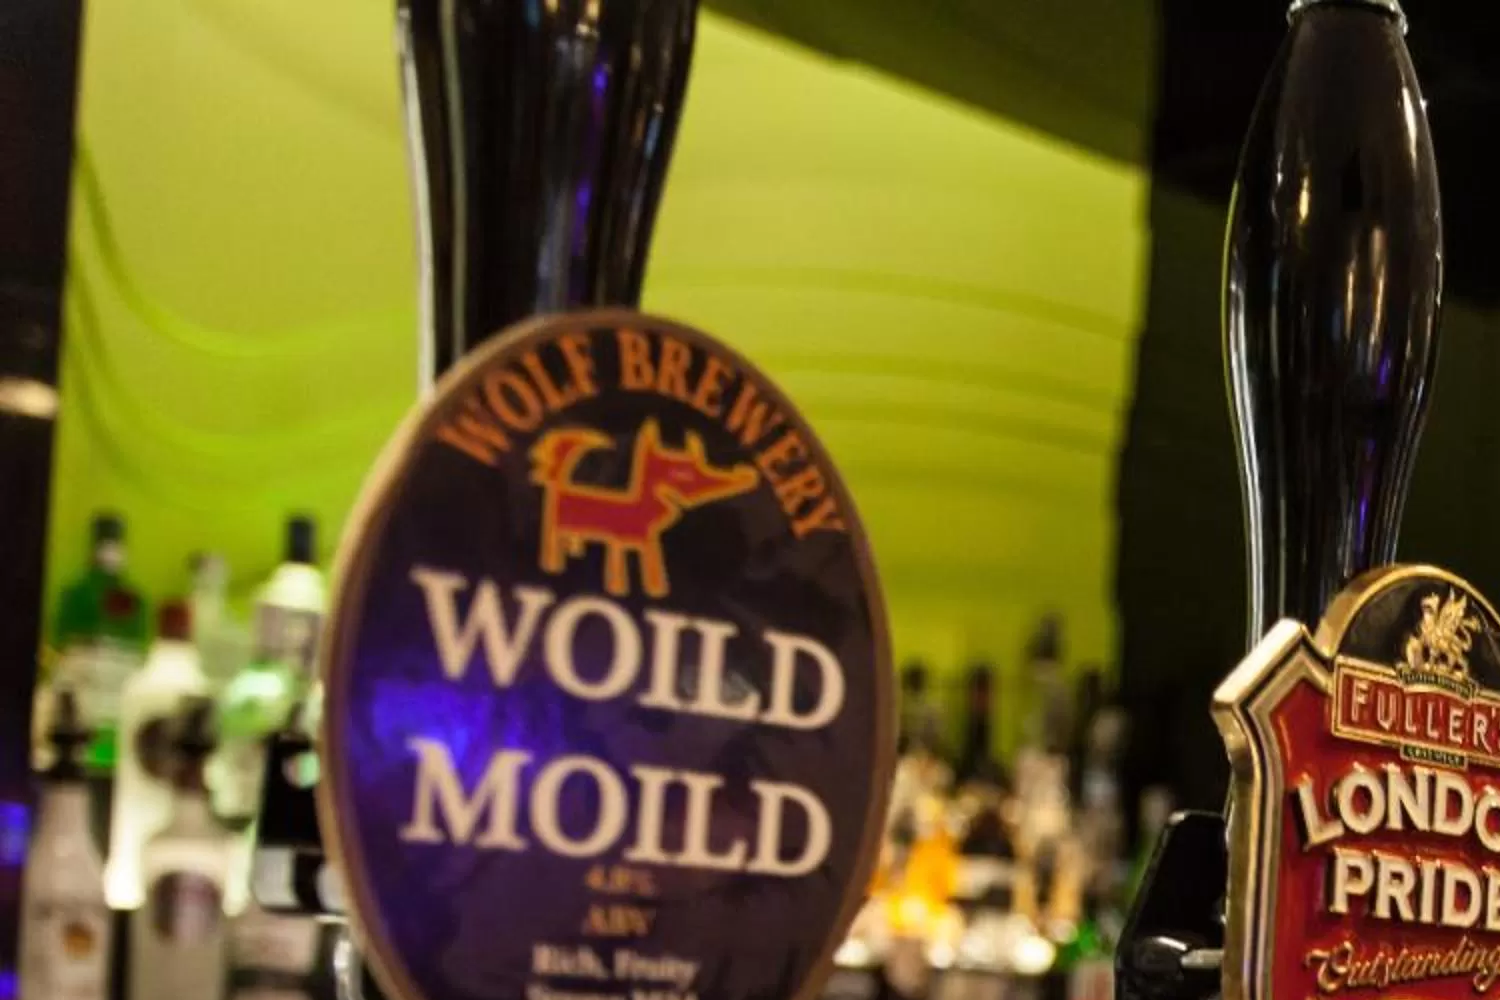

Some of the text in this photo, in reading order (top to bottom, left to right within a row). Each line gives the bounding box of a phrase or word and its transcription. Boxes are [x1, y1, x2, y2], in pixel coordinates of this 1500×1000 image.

[437, 330, 846, 538] WOLF BREWERY
[410, 563, 846, 730] WOILD
[398, 737, 833, 876] MOILD
